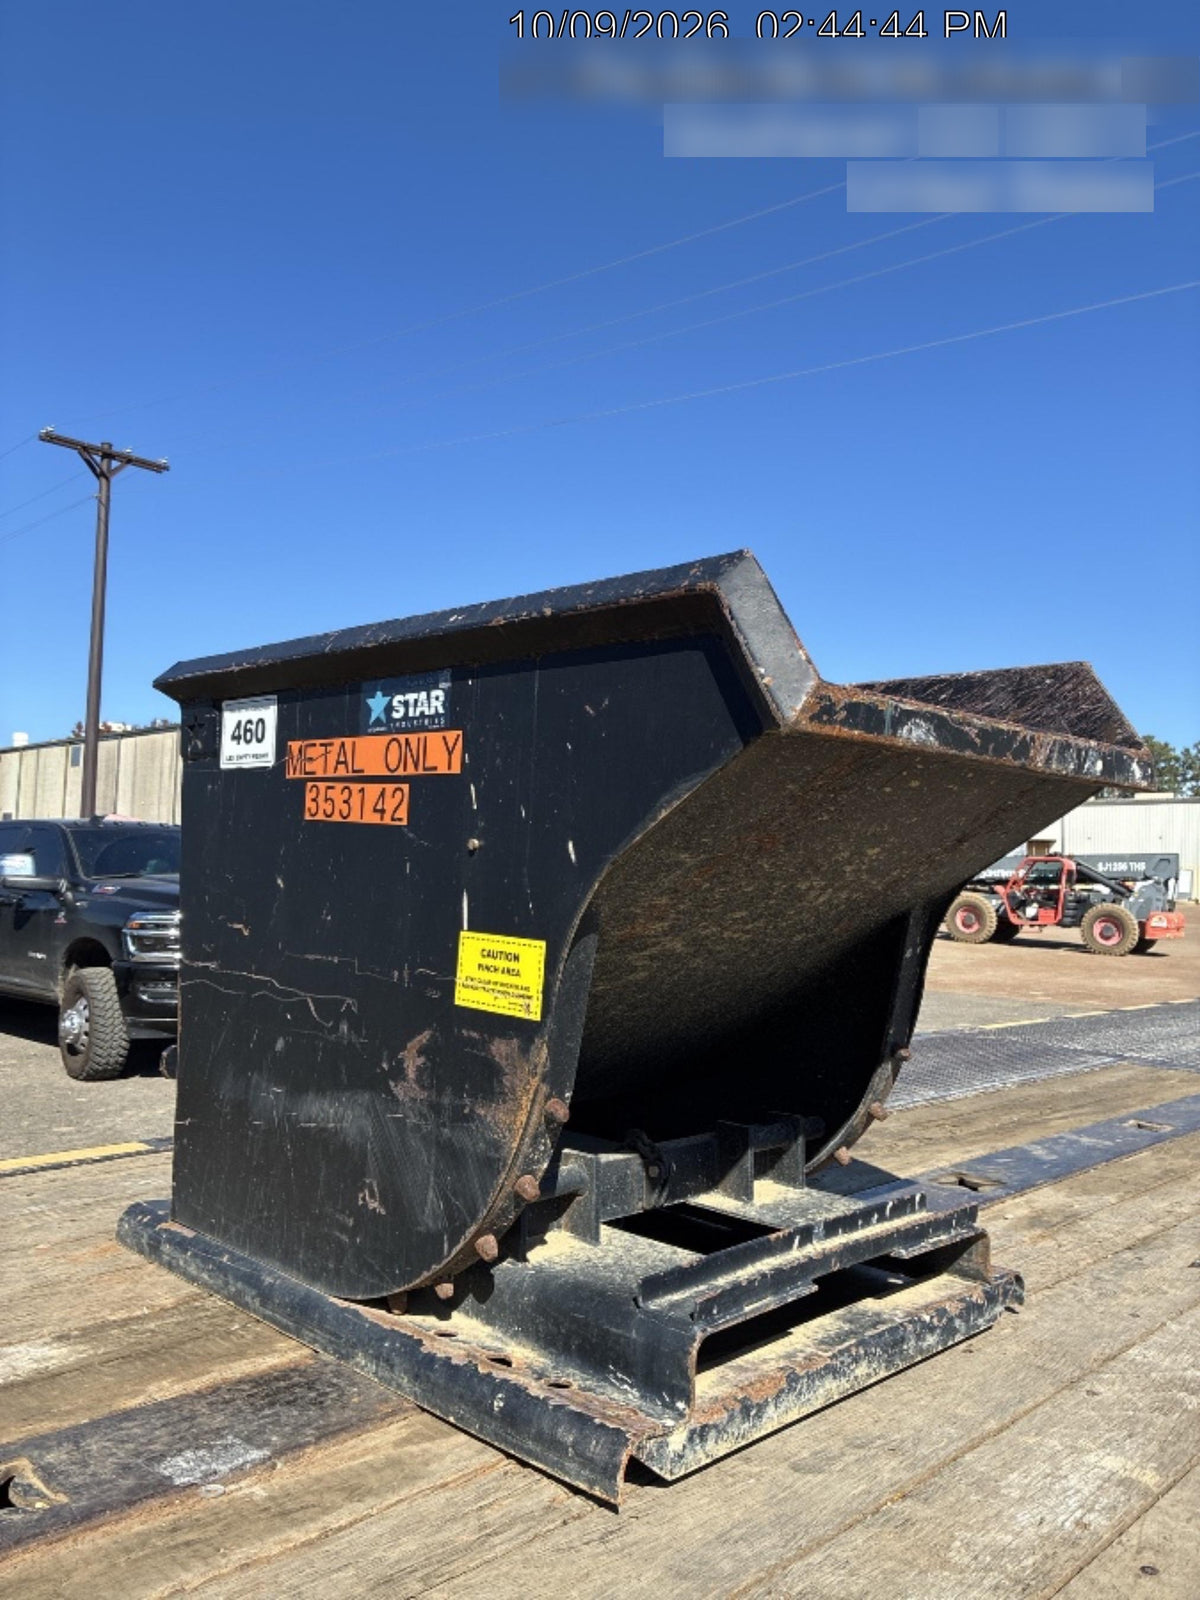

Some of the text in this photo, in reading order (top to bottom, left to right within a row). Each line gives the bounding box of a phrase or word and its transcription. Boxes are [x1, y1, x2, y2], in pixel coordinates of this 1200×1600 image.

[391, 689, 446, 719] STAR
[231, 717, 266, 745] 460
[287, 733, 460, 776] METAL ONLY
[307, 783, 406, 822] 353142
[480, 948, 520, 963] CAUTION
